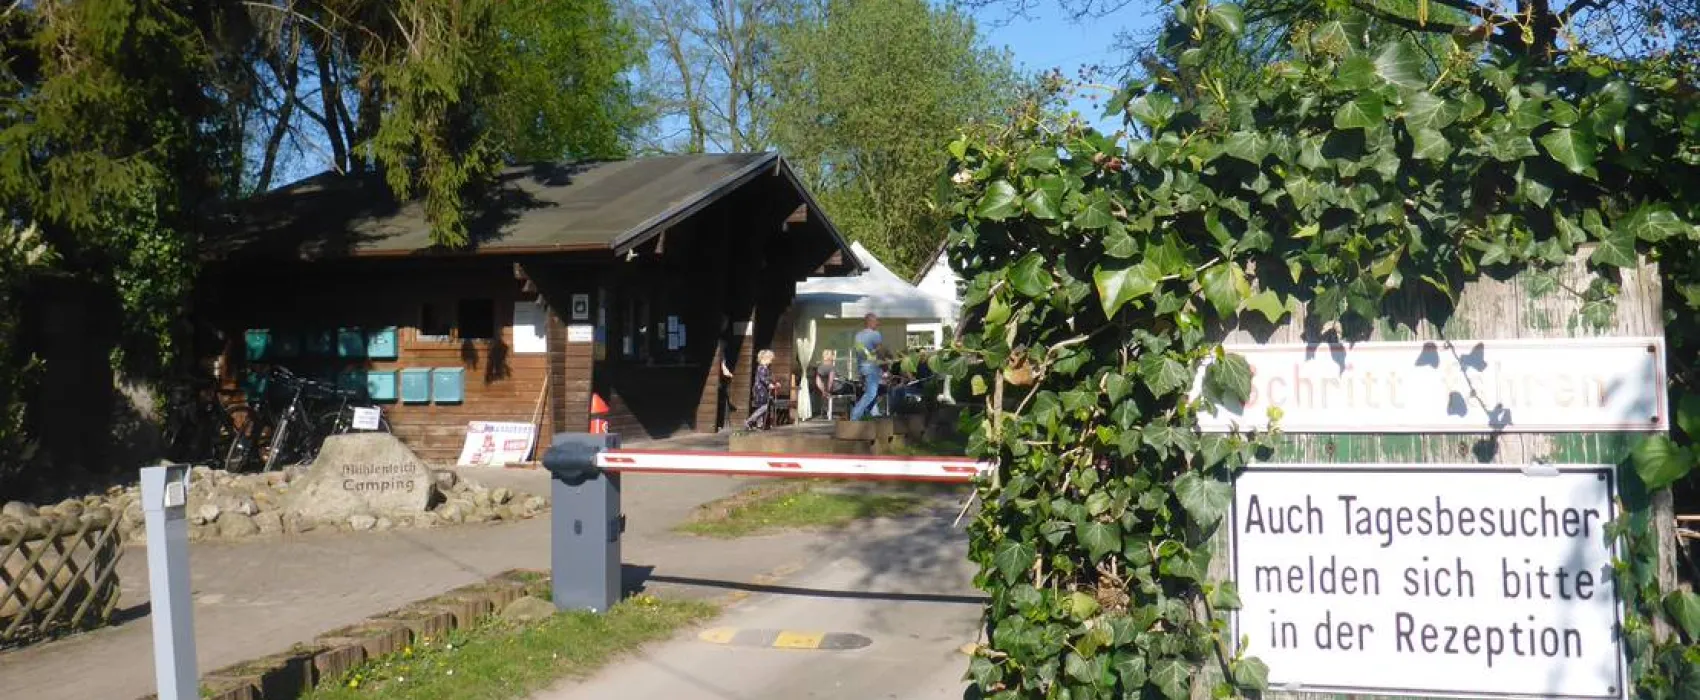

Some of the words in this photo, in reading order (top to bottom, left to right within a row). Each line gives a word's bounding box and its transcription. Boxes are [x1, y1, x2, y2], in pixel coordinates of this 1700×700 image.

[342, 478, 414, 493] Camping
[1245, 494, 1324, 535] Auch
[1337, 494, 1600, 547] Tagesbesucher
[1255, 555, 1380, 596] melden
[1403, 556, 1475, 598] sich
[1501, 557, 1595, 601] bitte
[1269, 608, 1298, 649] in
[1314, 609, 1375, 651] der
[1394, 611, 1583, 667] Rezeption
